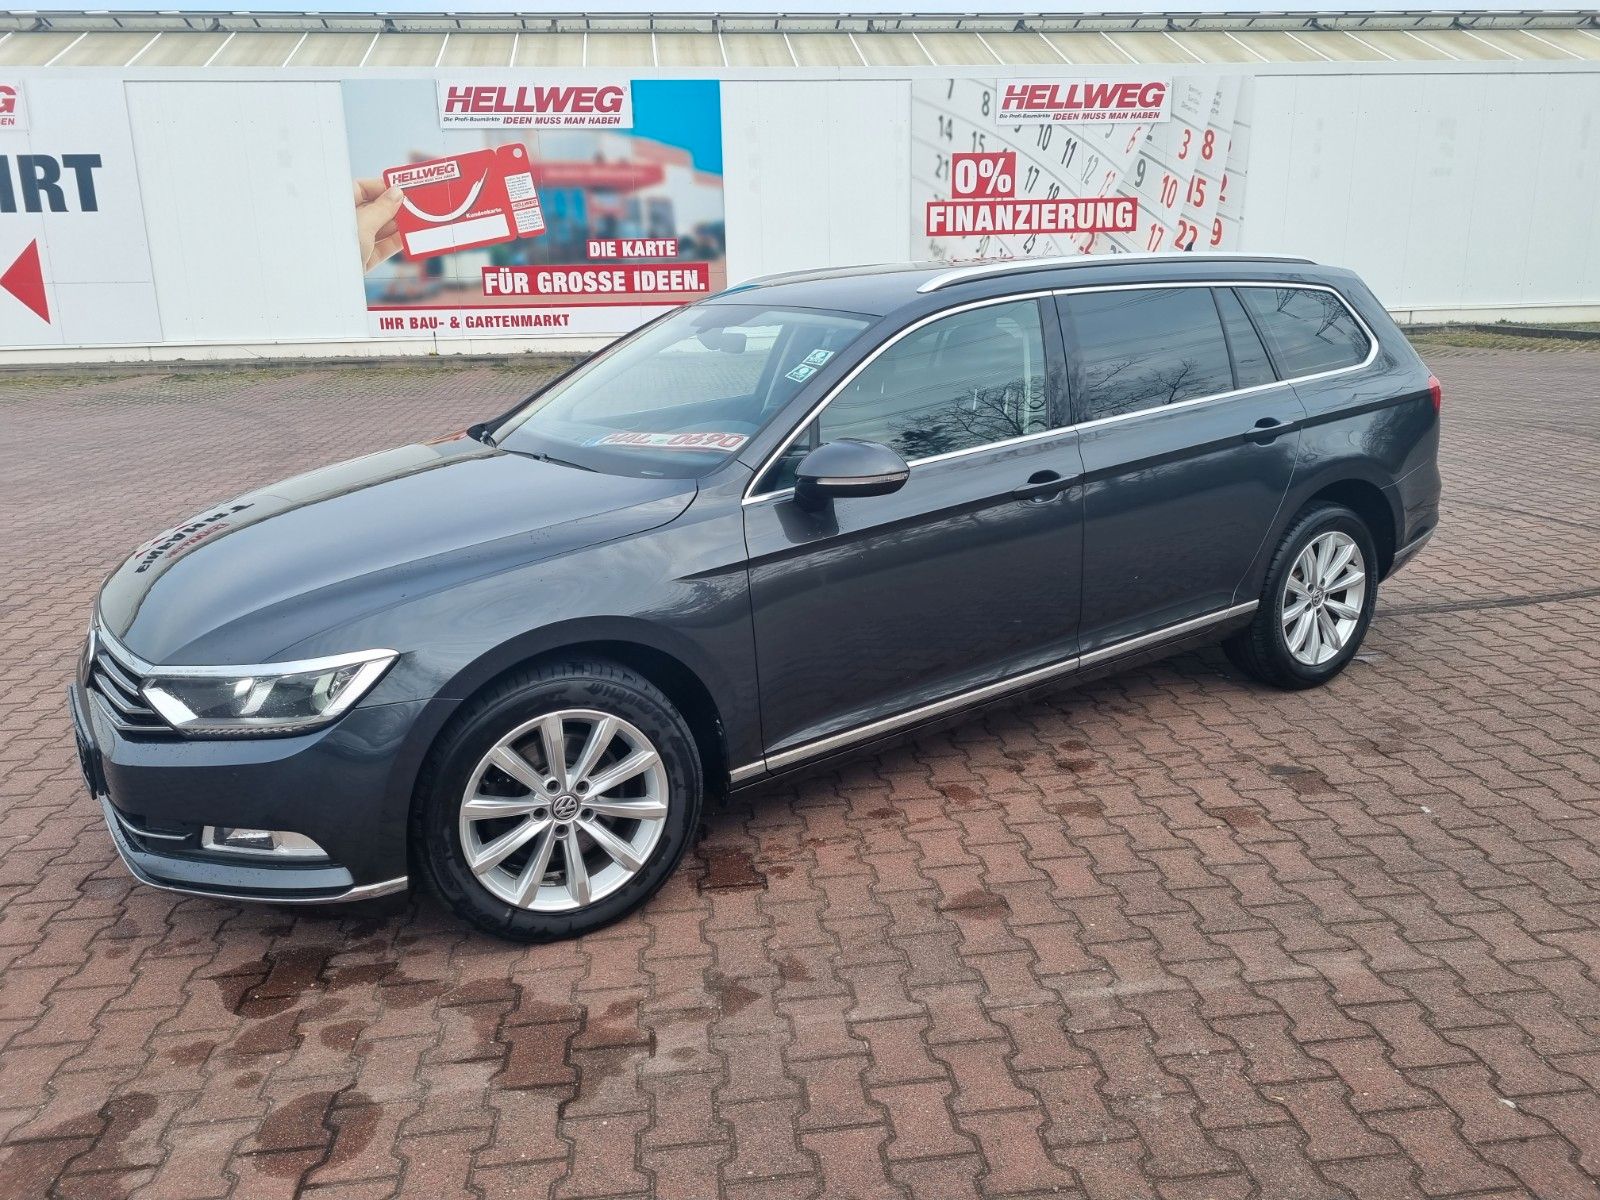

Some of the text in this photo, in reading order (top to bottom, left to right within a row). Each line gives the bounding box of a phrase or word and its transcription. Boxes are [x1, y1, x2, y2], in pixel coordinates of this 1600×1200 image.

[445, 86, 624, 113] HELLWEG
[982, 91, 990, 116] 8
[1002, 82, 1165, 110] HELLWEG
[503, 117, 532, 125] IDEEN
[535, 117, 561, 125] MUSS
[588, 116, 620, 124] HABEN
[938, 115, 952, 141] 14
[1082, 112, 1106, 120] MUSS
[1037, 124, 1052, 151] 10
[1179, 129, 1191, 160] 3
[1202, 130, 1215, 160] 8
[1061, 138, 1077, 168] 11
[393, 164, 454, 184] HELLWEG
[955, 158, 1012, 194] 0%
[1025, 166, 1040, 193] 17
[1135, 159, 1146, 187] 9
[1161, 175, 1177, 208] 10
[1187, 174, 1206, 207] 15
[929, 202, 1133, 232] FINANZIERUNG
[589, 240, 676, 257] DIE KARTE
[1147, 224, 1164, 252] 17
[485, 268, 705, 294] FÜR GROSSE IDEEN.
[380, 314, 570, 330] IHR BAU- & GARTENMARKT
